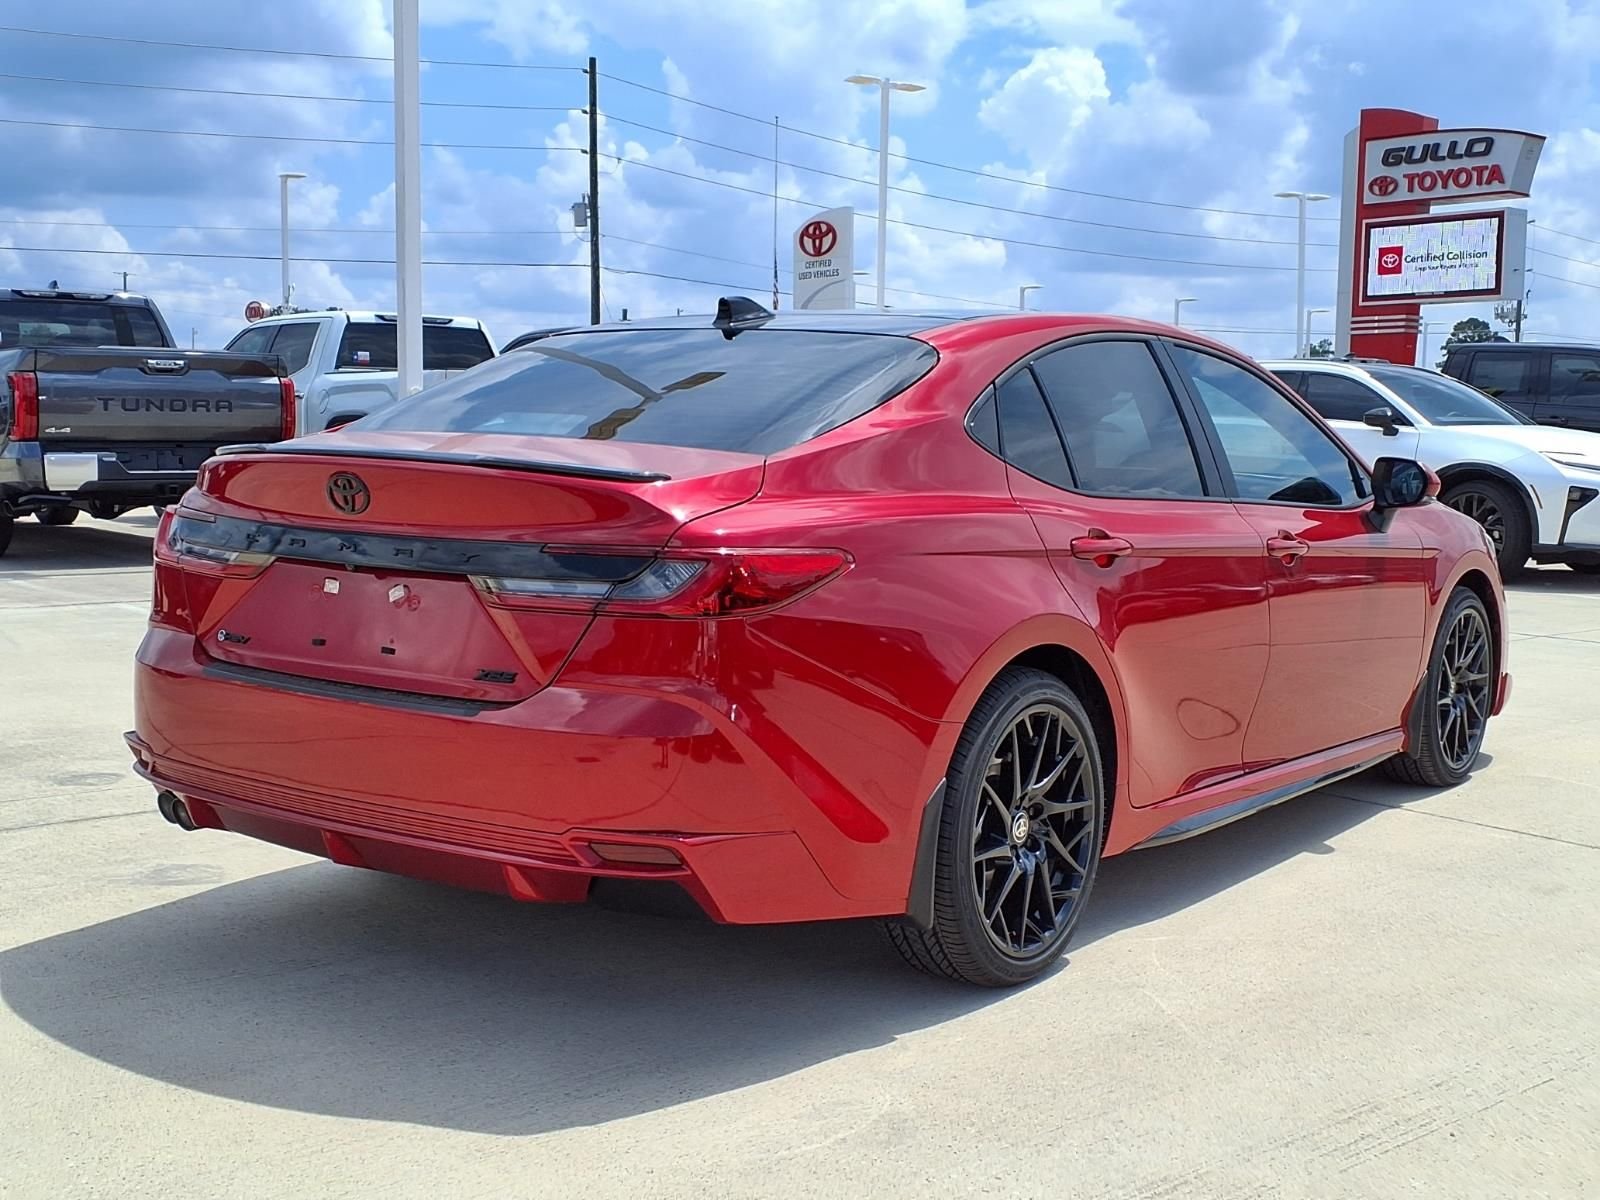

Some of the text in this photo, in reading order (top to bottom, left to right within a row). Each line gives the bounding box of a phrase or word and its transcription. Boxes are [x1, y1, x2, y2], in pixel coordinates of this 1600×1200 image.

[1381, 136, 1495, 167] GULLO
[1402, 164, 1505, 193] TOYOTA
[805, 259, 832, 269] CERTIFIED
[1404, 250, 1488, 264] Certified Collision
[798, 268, 840, 280] USED VEHICLES
[96, 397, 233, 413] TUNDRA
